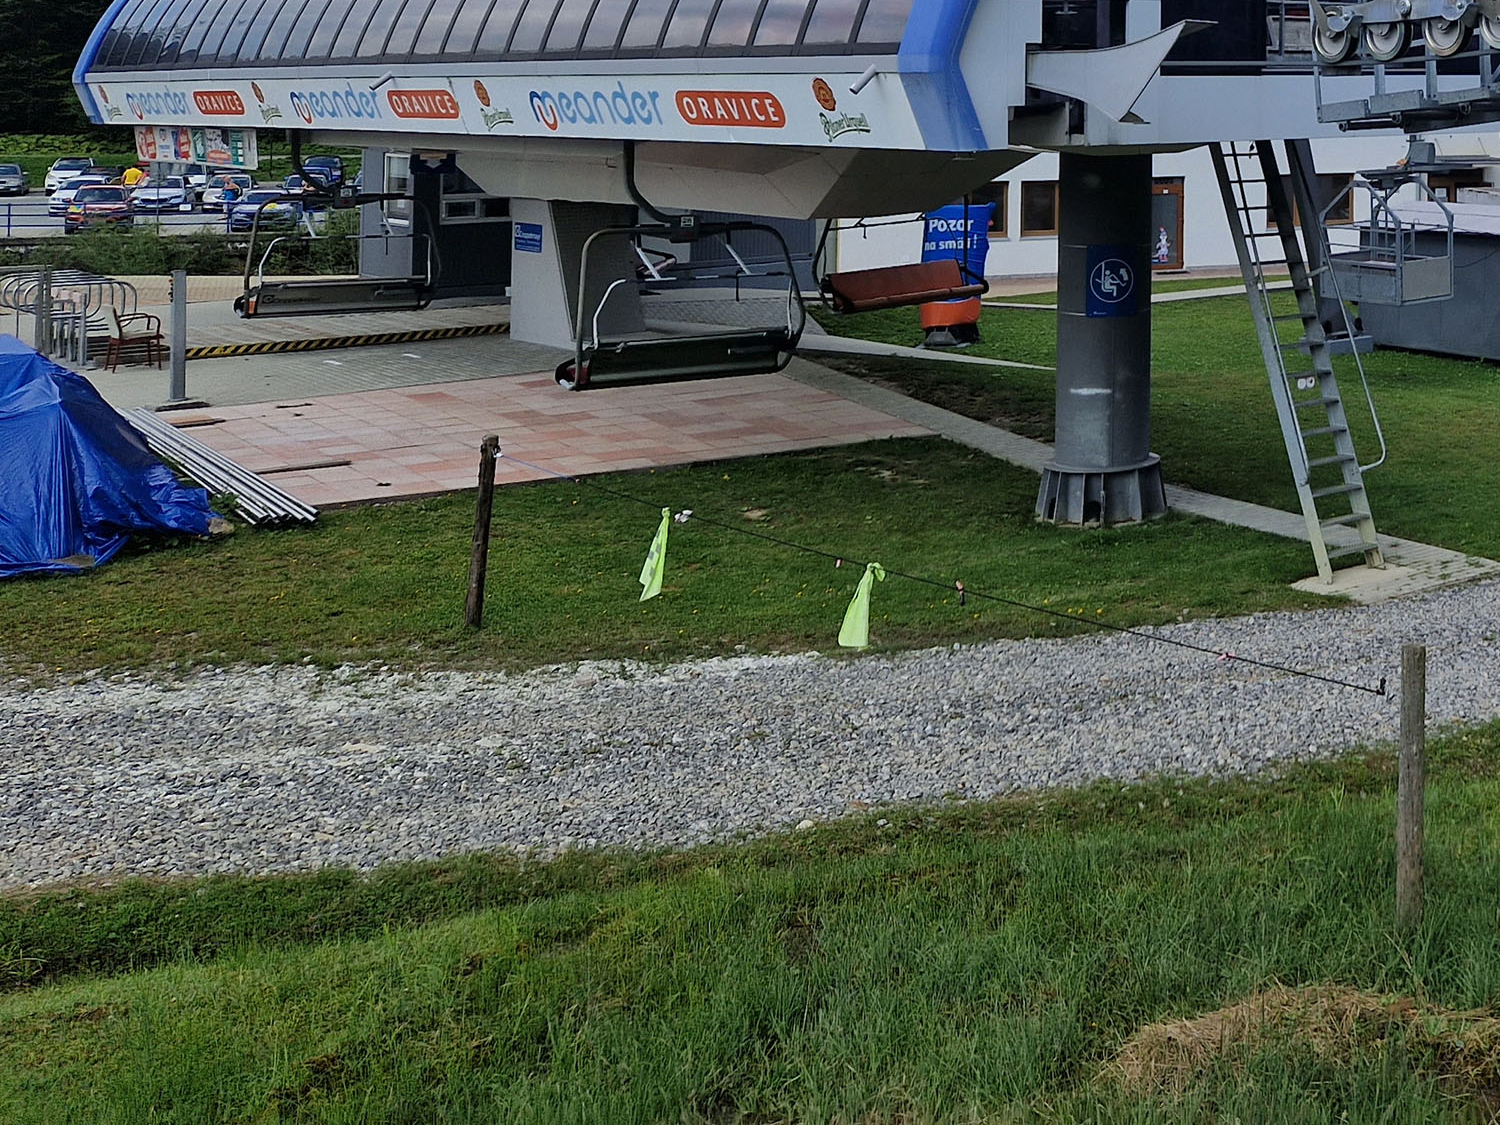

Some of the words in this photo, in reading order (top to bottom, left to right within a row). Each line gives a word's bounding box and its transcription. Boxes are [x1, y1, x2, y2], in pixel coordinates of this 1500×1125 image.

[196, 94, 243, 111] ORAVICE
[392, 94, 455, 114] ORAVICE
[682, 96, 780, 122] ORAVICE
[929, 219, 974, 233] Pozor
[924, 241, 936, 251] na
